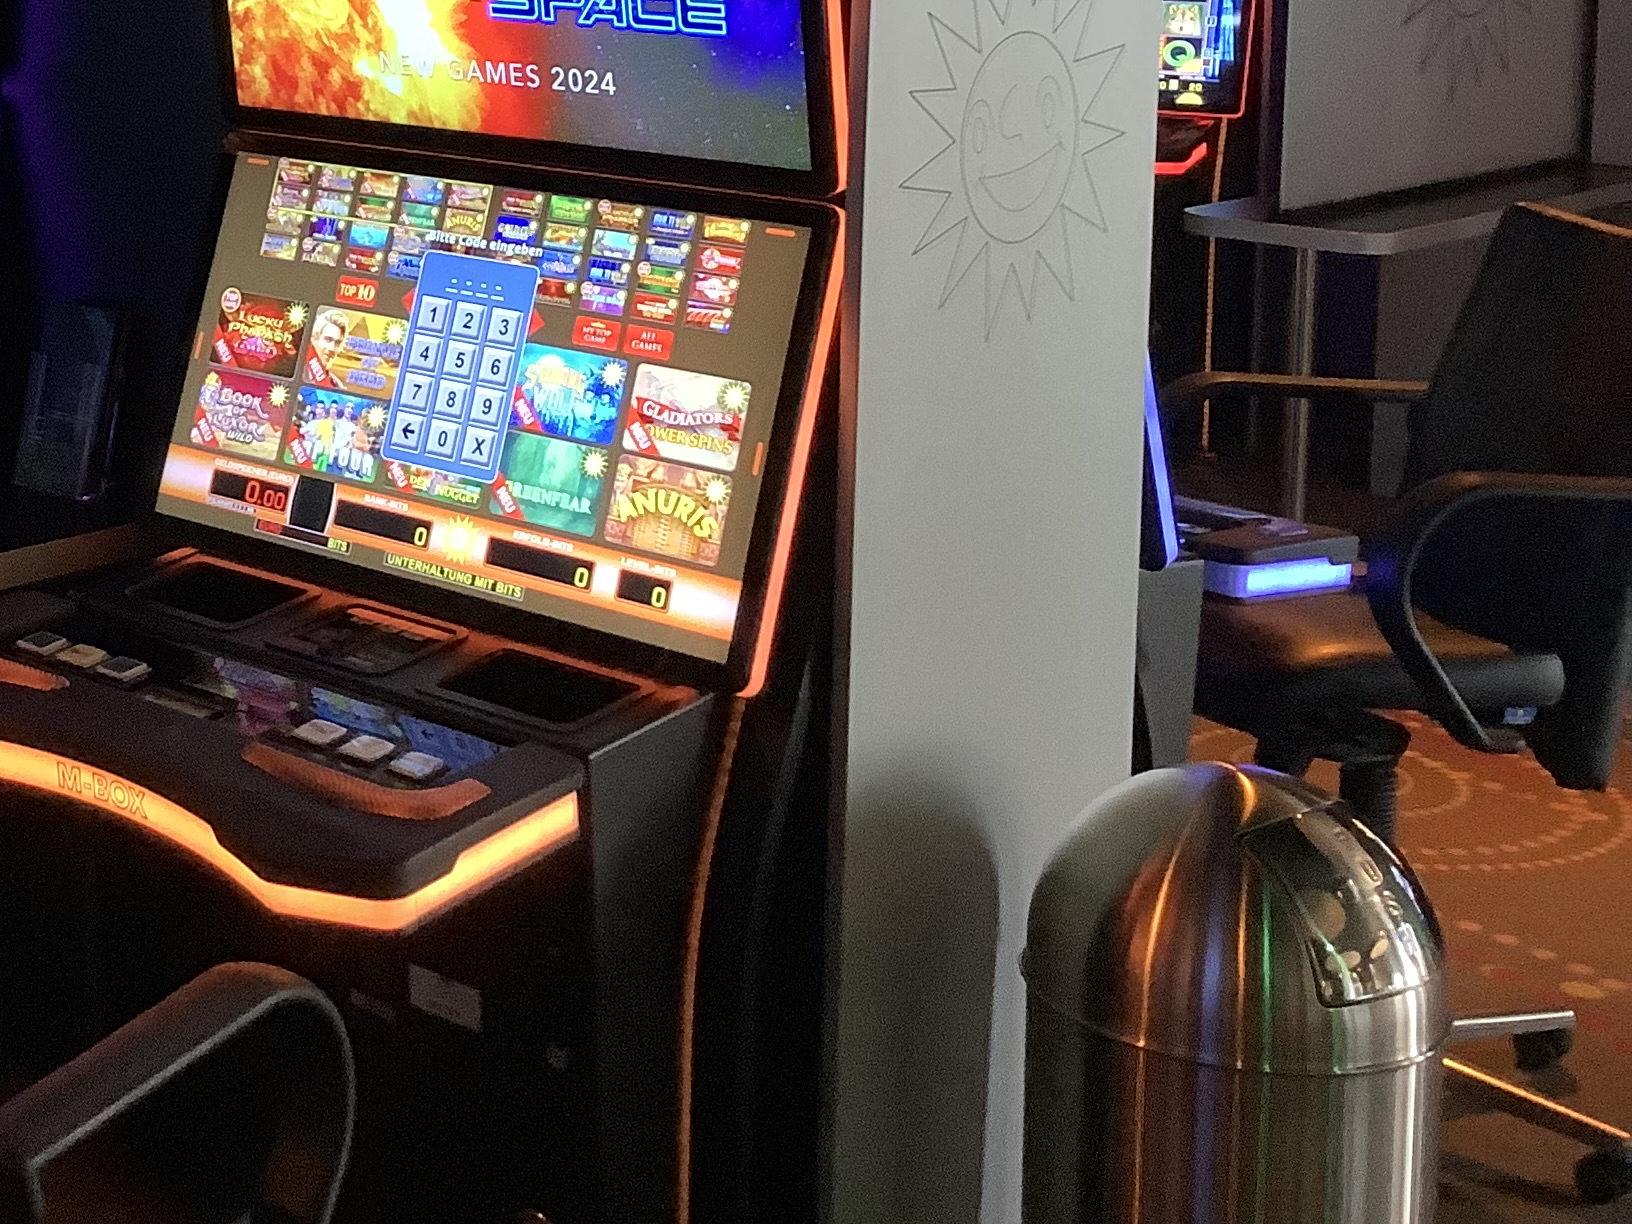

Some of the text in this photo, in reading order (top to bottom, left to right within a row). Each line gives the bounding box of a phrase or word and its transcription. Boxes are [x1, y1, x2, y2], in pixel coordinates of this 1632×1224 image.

[379, 51, 617, 97] NEW GAMES 2024
[446, 214, 481, 232] ANURIS
[425, 230, 543, 258] Bitte Code eingeben
[340, 283, 376, 301] TOP 10
[431, 307, 437, 322] 1
[463, 313, 473, 329] 2
[499, 319, 509, 335] 3
[640, 331, 656, 342] ALL
[215, 339, 232, 363] NEU
[420, 346, 429, 361] 4
[632, 340, 663, 353] GAMES
[309, 357, 325, 382] NEU
[455, 352, 465, 368] 5
[491, 359, 501, 375] 6
[413, 384, 422, 399] 7
[446, 391, 456, 407] 8
[482, 399, 492, 415] 9
[515, 398, 534, 425] NEU
[642, 401, 734, 426] GLADIATORS
[198, 417, 213, 442] NEU
[438, 431, 447, 447] 0
[630, 421, 651, 450] NEU
[647, 425, 733, 454] OWER SPINS
[290, 439, 307, 464] NEU
[472, 438, 485, 455] X
[389, 462, 407, 488] NEU
[245, 480, 286, 510] 0.00
[435, 483, 480, 504] NUGGET
[497, 486, 516, 514] NEU
[618, 487, 718, 539] ANURIS
[328, 538, 348, 552] BITS
[414, 527, 427, 546] 0
[386, 553, 522, 598] UNTERHALTUNG MIT BITS
[574, 567, 588, 588] 0
[651, 586, 666, 608] 0
[57, 761, 148, 819] M-BOX
